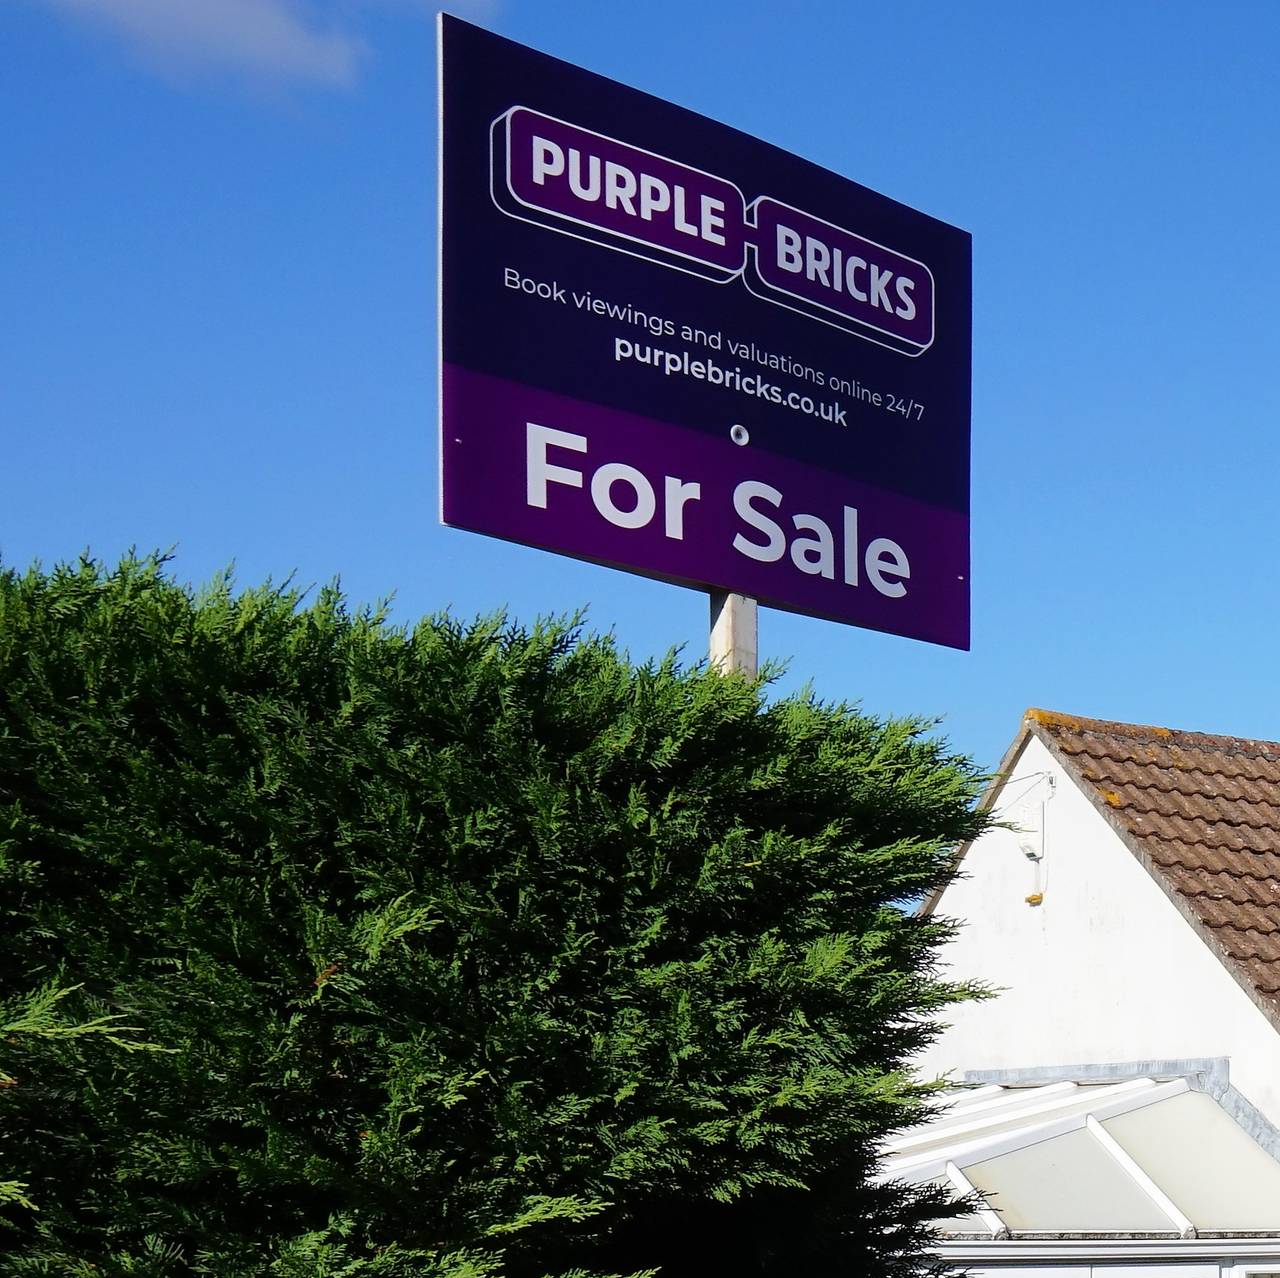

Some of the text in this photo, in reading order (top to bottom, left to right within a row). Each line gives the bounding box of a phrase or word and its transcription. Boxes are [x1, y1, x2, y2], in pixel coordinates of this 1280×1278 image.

[532, 135, 917, 321] PURPLE BRICKS
[504, 267, 925, 422] Book viewings and valuations online 24/7
[614, 337, 848, 428] purplebricks.co.uk
[526, 421, 912, 598] For Sale
